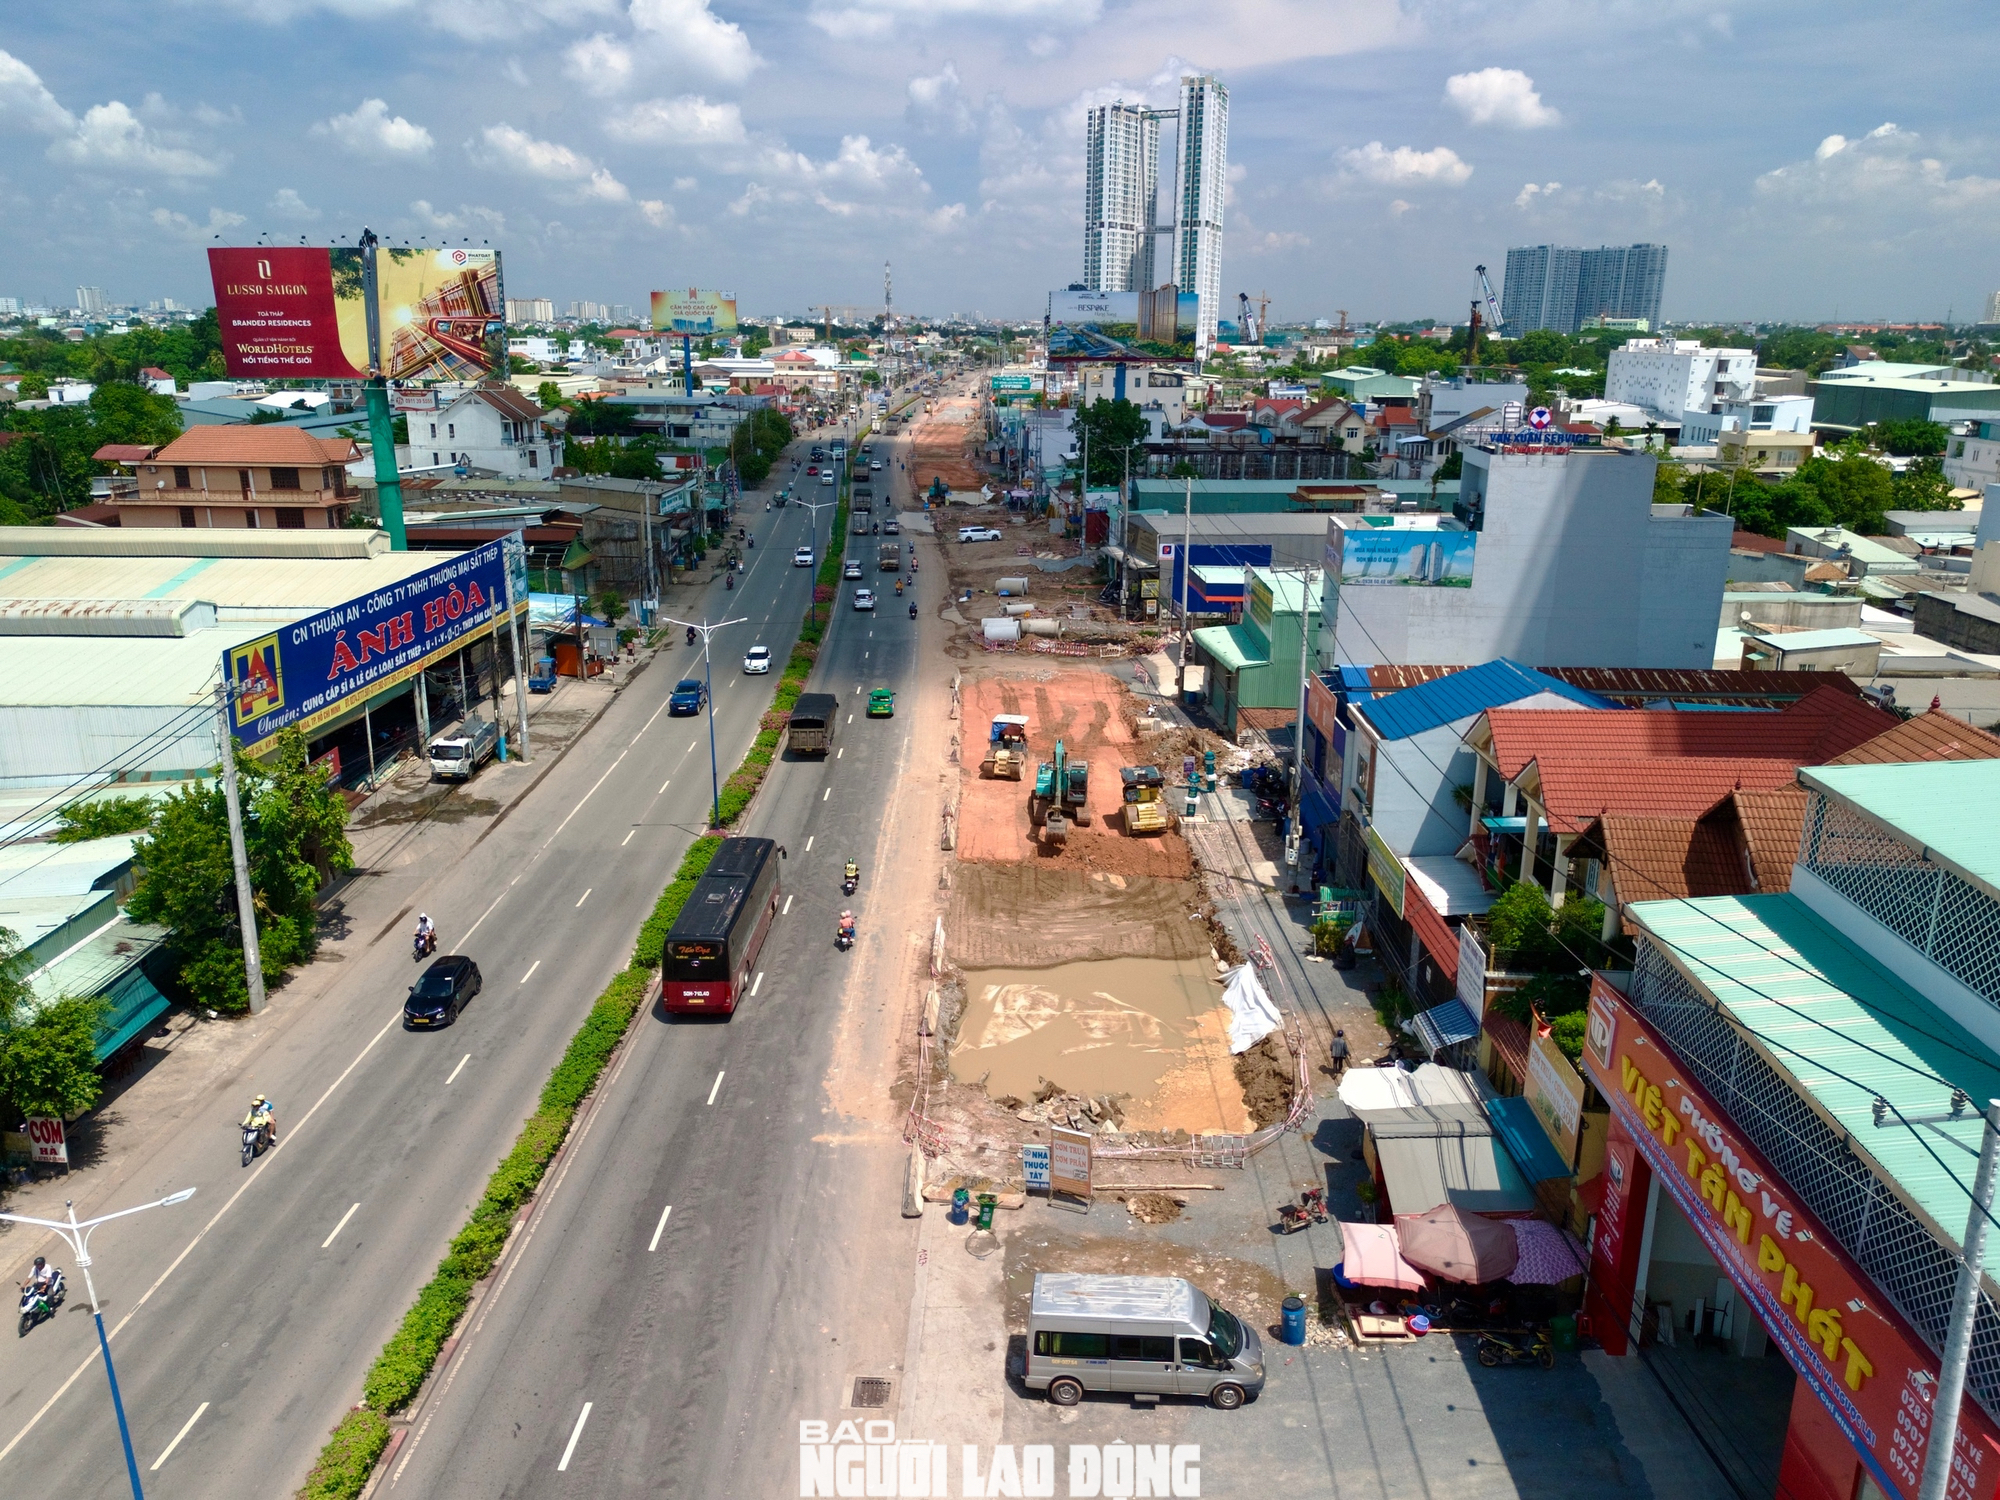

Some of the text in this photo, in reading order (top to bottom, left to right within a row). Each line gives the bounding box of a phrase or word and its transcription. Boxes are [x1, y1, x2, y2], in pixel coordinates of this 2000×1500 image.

[227, 285, 307, 295] LUSSO SAIGON
[1544, 434, 1590, 443] SERVICE
[293, 626, 308, 645] CN
[310, 610, 344, 632] THUẬN
[346, 606, 360, 624] AN
[367, 592, 392, 614] CÔNG
[394, 586, 406, 602] TY
[407, 580, 428, 598] TNHH
[429, 566, 457, 588] THƯƠNG
[458, 563, 469, 576] MẠI
[470, 552, 483, 569] SẮT
[483, 545, 498, 564] THÉP
[327, 610, 415, 680] ÁNH
[423, 580, 485, 633] HÒA
[258, 706, 299, 735] Chuyên:
[302, 693, 324, 713] CUNG
[325, 684, 339, 701] CẤP
[349, 680, 355, 689] &
[365, 666, 377, 680] CÁC
[378, 657, 394, 673] LOẠI
[395, 651, 406, 667] SẮT
[407, 644, 421, 662] THÉP
[462, 616, 474, 631] THÉP
[330, 703, 341, 716] MINH
[29, 1118, 63, 1144] CƠM
[40, 1146, 58, 1155] HÀ
[1032, 1150, 1048, 1159] NHÀ
[1055, 1143, 1086, 1156] CƠM TRƯA
[1055, 1155, 1086, 1168] CƠM PHẦN
[1024, 1160, 1048, 1170] THUỐC
[1029, 1171, 1043, 1179] TÂY
[1622, 1055, 1873, 1391] VIỆT TÂN PHÁT
[1660, 1170, 1672, 1189] BÌNH
[1672, 1187, 1691, 1214] DƯƠNG
[1694, 1216, 1704, 1234] KHU
[1705, 1231, 1717, 1249] PHỐ
[1738, 1277, 1764, 1314] PHƯỜNG
[1764, 1313, 1779, 1336] BÌNH
[1780, 1334, 1794, 1358] HÒA
[1820, 1392, 1834, 1413] CHÍ
[1835, 1412, 1856, 1442] MINH
[1693, 1196, 1712, 1224] KHÁCH
[1752, 1274, 1765, 1297] CÁC
[1765, 1289, 1780, 1319] TỈNH
[1780, 1310, 1794, 1335] TÂY
[1793, 1328, 1823, 1376] NGUYÊN
[1822, 1367, 1834, 1392] VÀ
[1833, 1382, 1863, 1428] NGƯỢC
[1862, 1420, 1877, 1448] LẠI
[1902, 1389, 1928, 1428] 0283
[1897, 1409, 1925, 1448] 0907
[1893, 1428, 1919, 1469] 0972
[1969, 1443, 1983, 1465] VÉ
[1890, 1447, 1915, 1486] 0979
